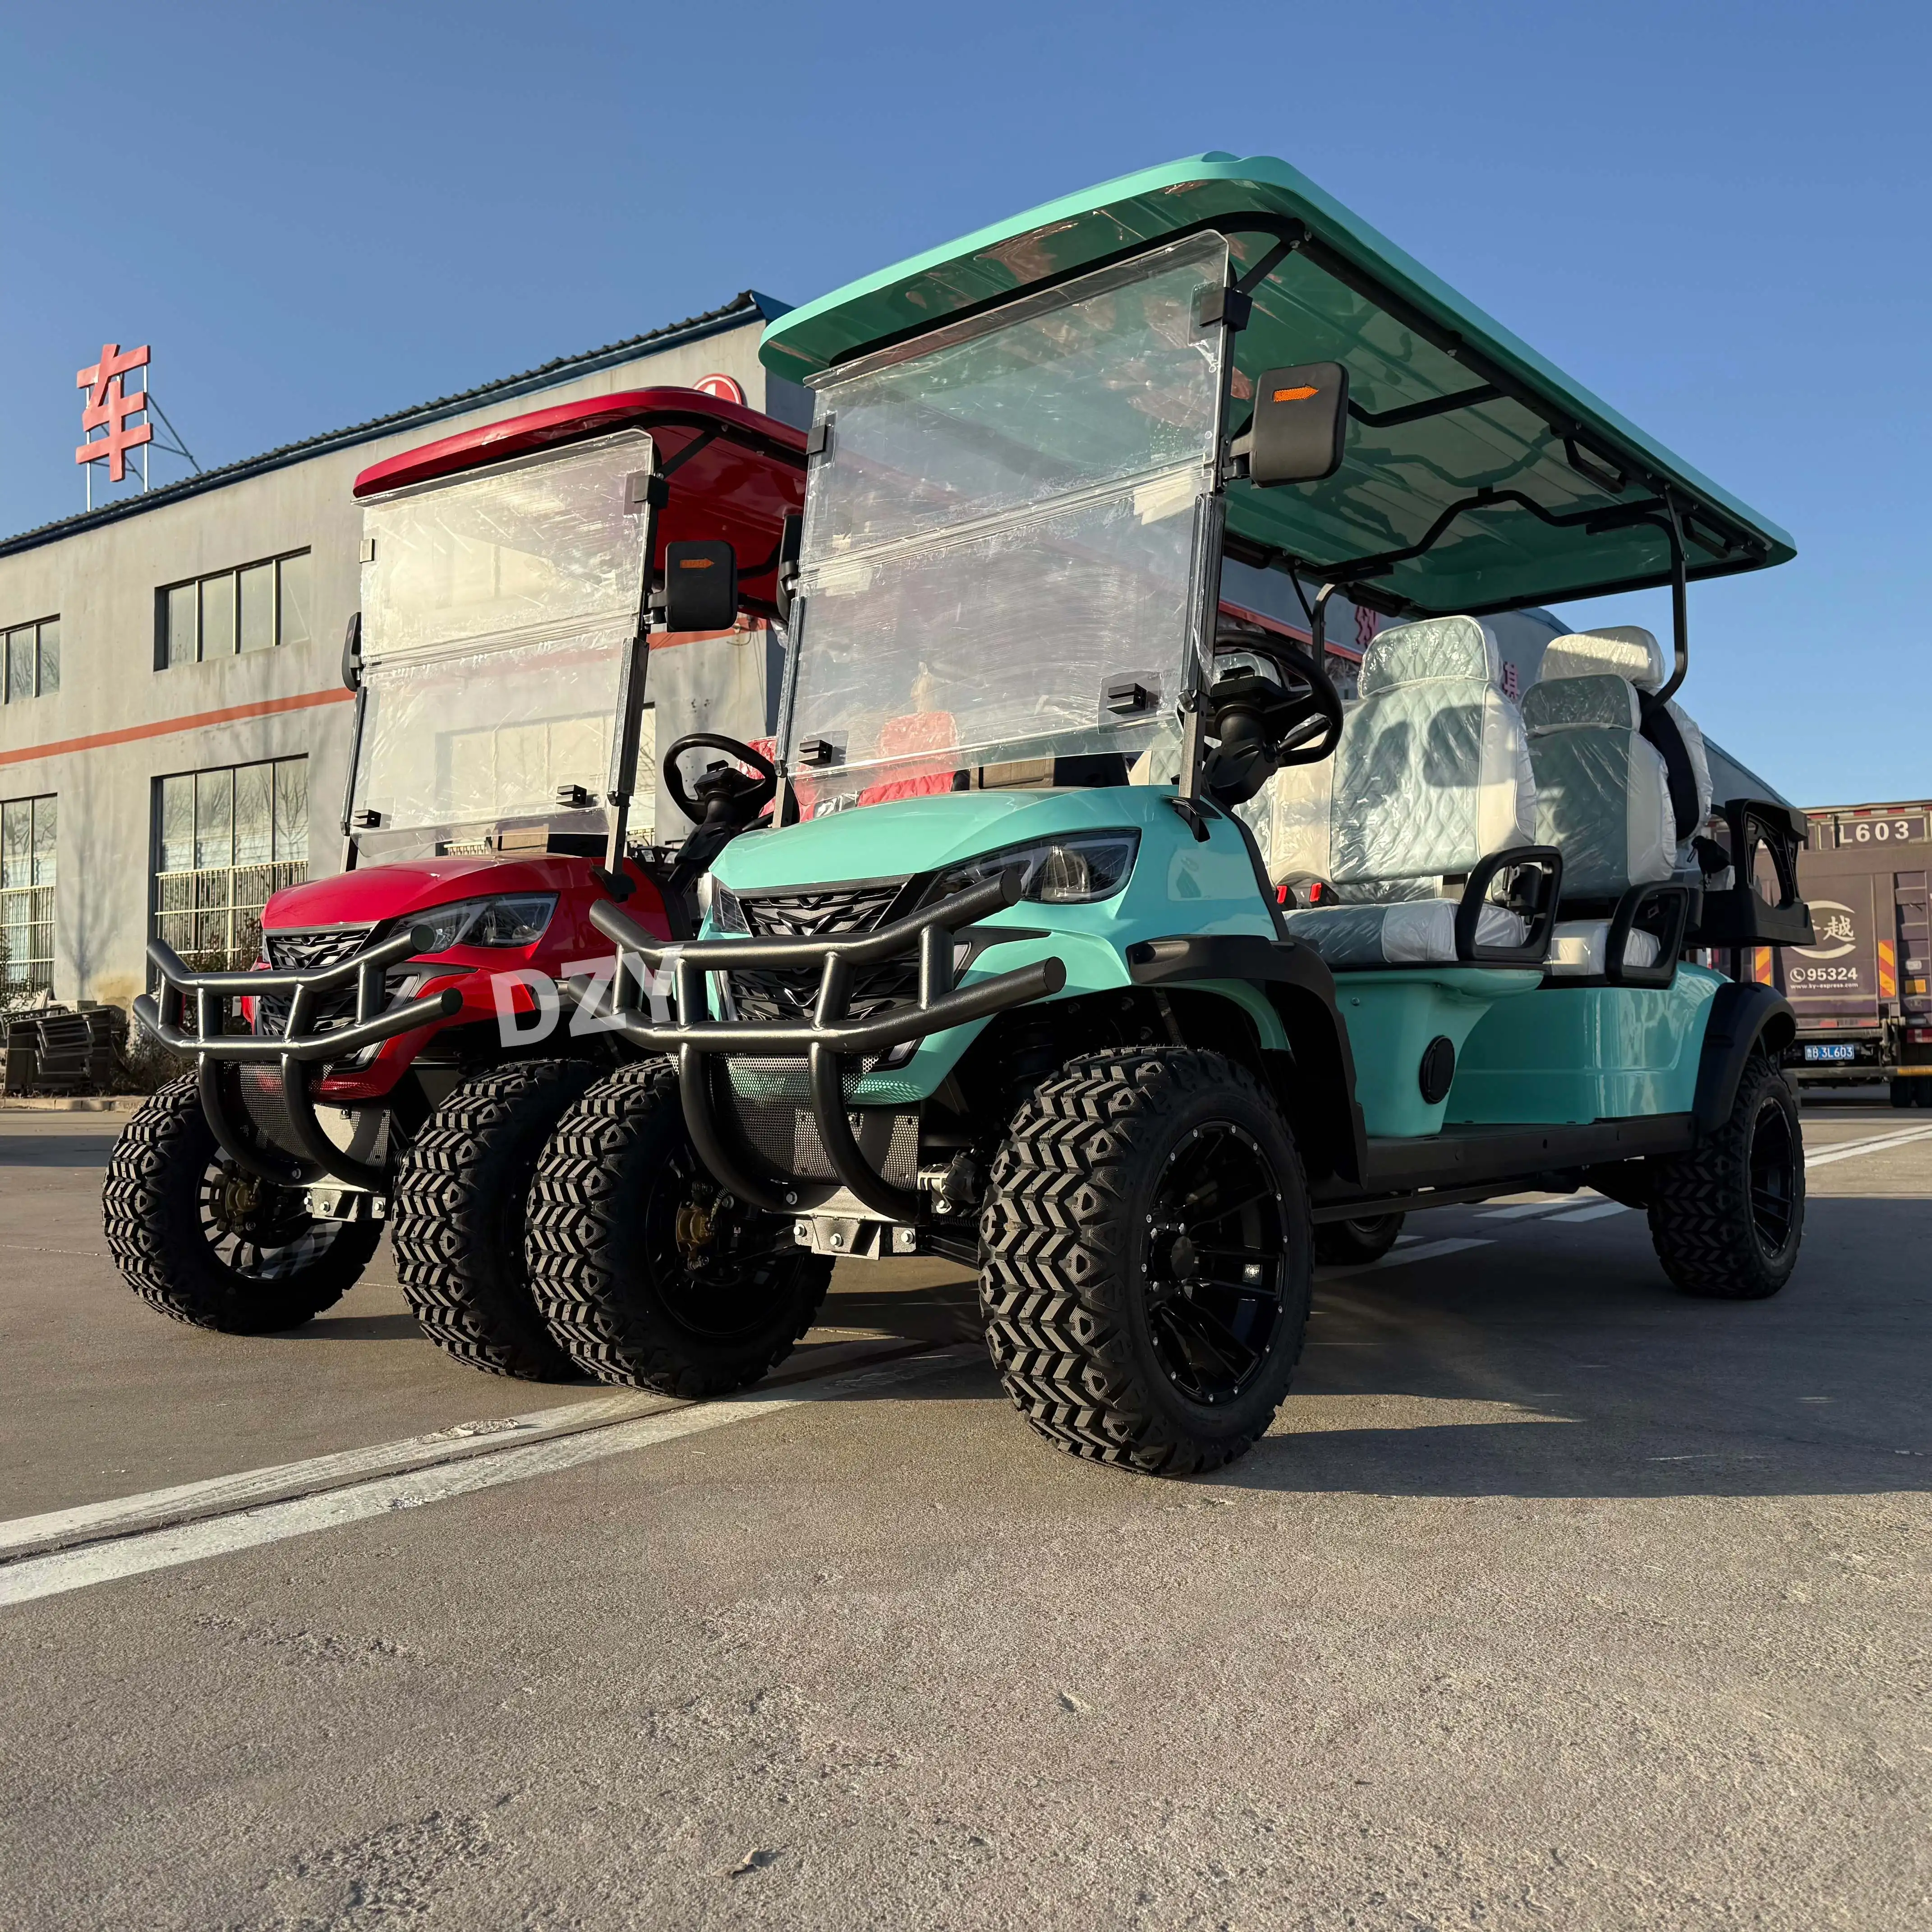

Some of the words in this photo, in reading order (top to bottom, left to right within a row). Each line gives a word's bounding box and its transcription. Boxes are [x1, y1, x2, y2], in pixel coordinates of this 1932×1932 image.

[75, 344, 153, 482] 车
[1811, 915, 1856, 942] 越
[1807, 967, 1858, 981] 95324
